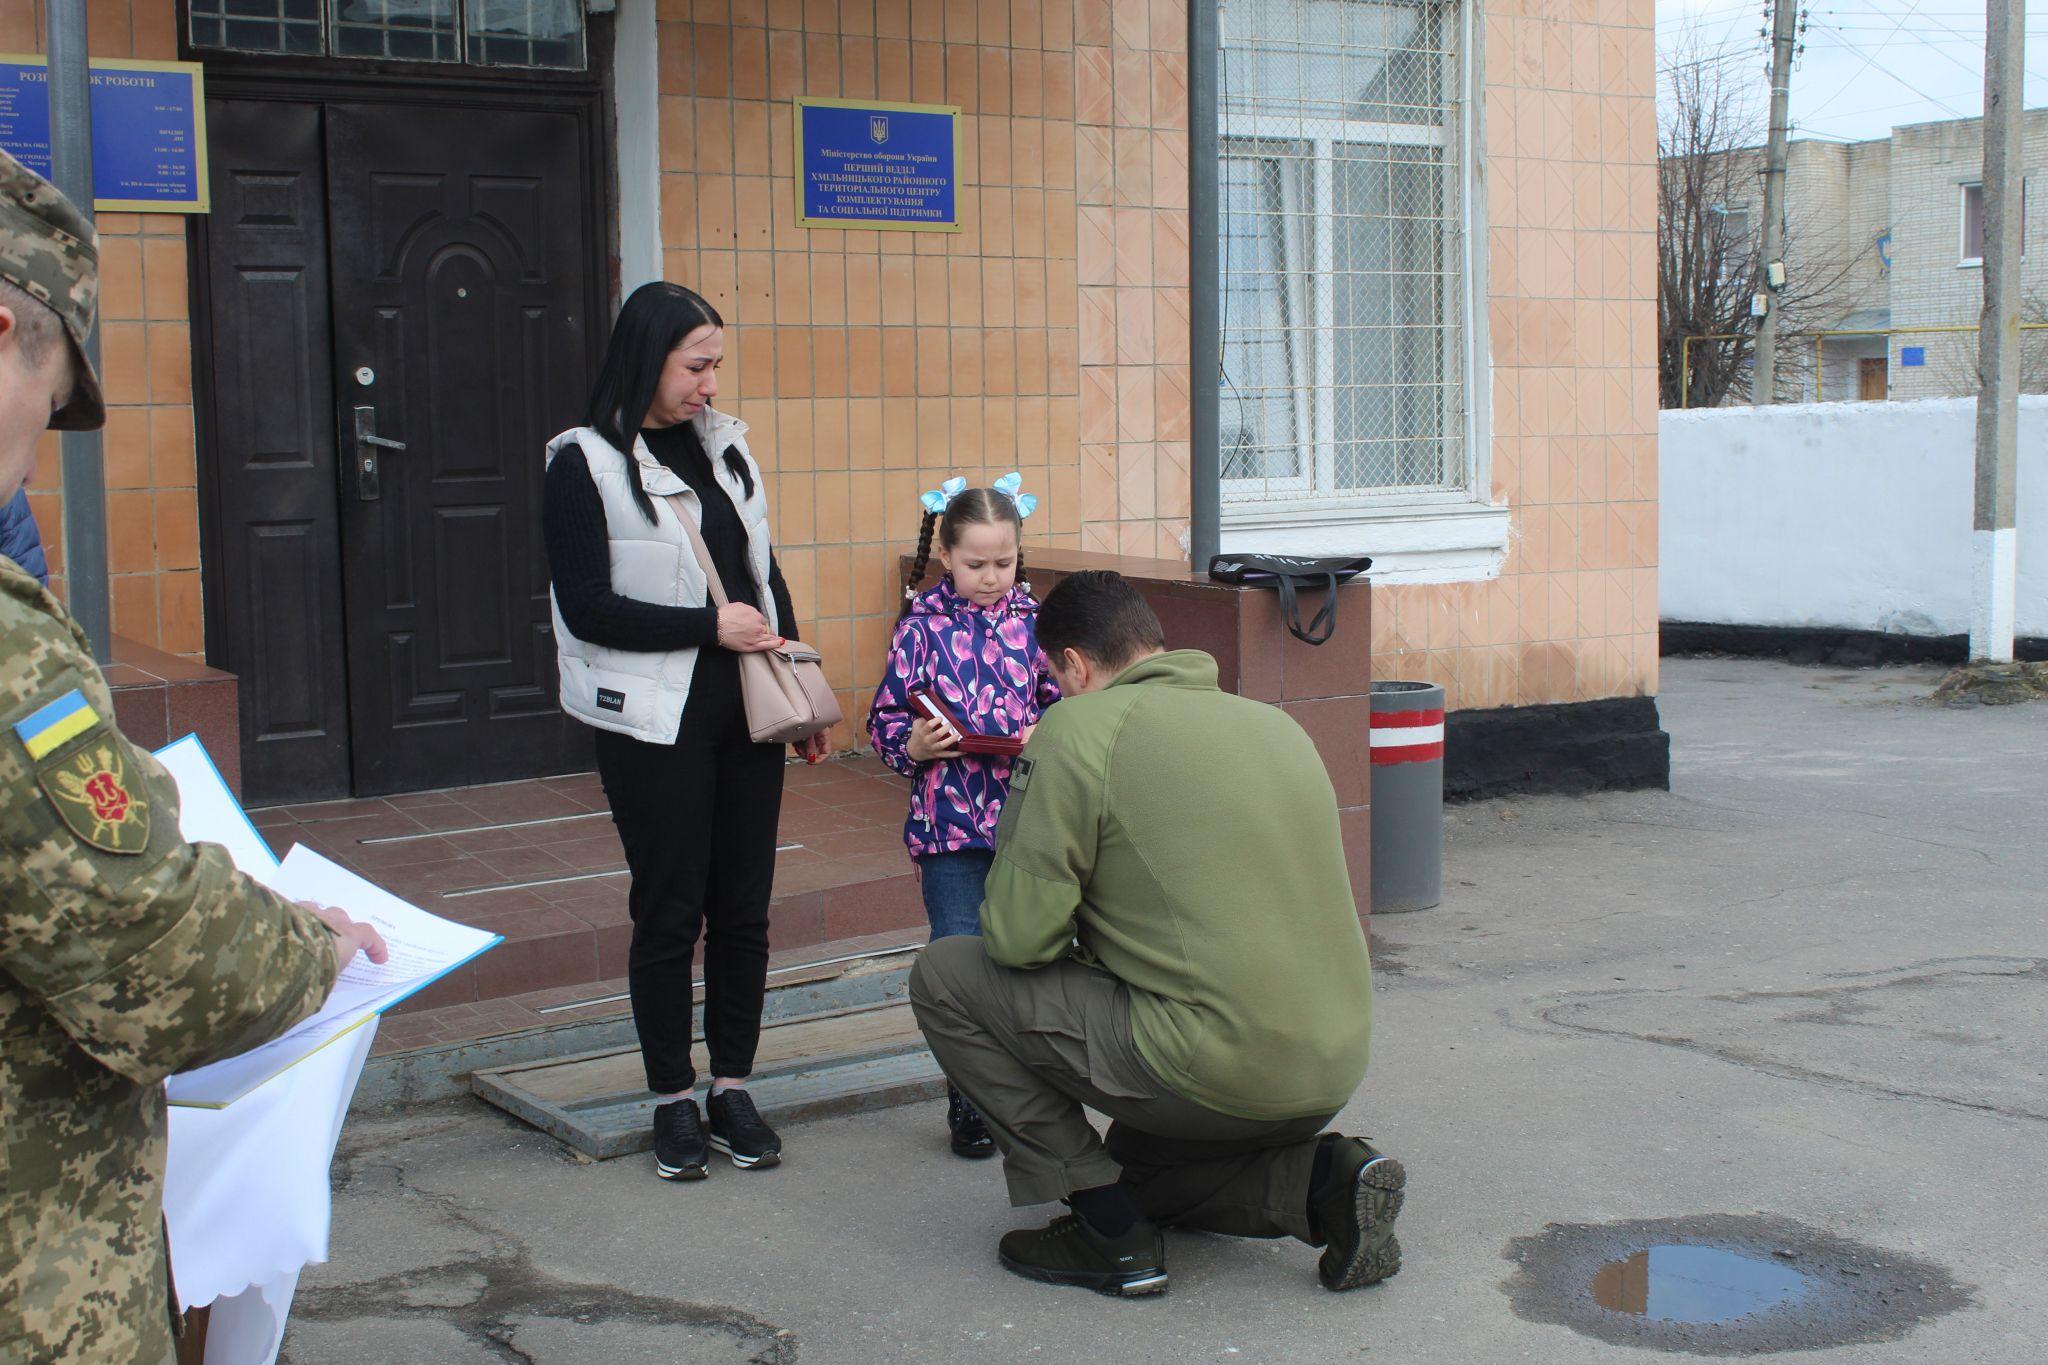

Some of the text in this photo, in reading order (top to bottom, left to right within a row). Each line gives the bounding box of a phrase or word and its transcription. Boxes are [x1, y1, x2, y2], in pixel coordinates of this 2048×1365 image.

[106, 75, 155, 88] РОБОТИ
[821, 149, 938, 163] Міністерство оборони України
[844, 163, 915, 174] ПЕРШИЙ ВІДДІЛ
[811, 172, 947, 186] ХМІЛЬНИЦЬКОГО РАЙОННОГО
[818, 183, 941, 197] ТЕРИТОРІАЛЬНОГО ЦЕНТРУ
[837, 195, 923, 206] КОМПЛЕКТУВАННЯ
[817, 204, 943, 219] ТА СОЦІАЛЬНОЇ ПІДТРИМКИ
